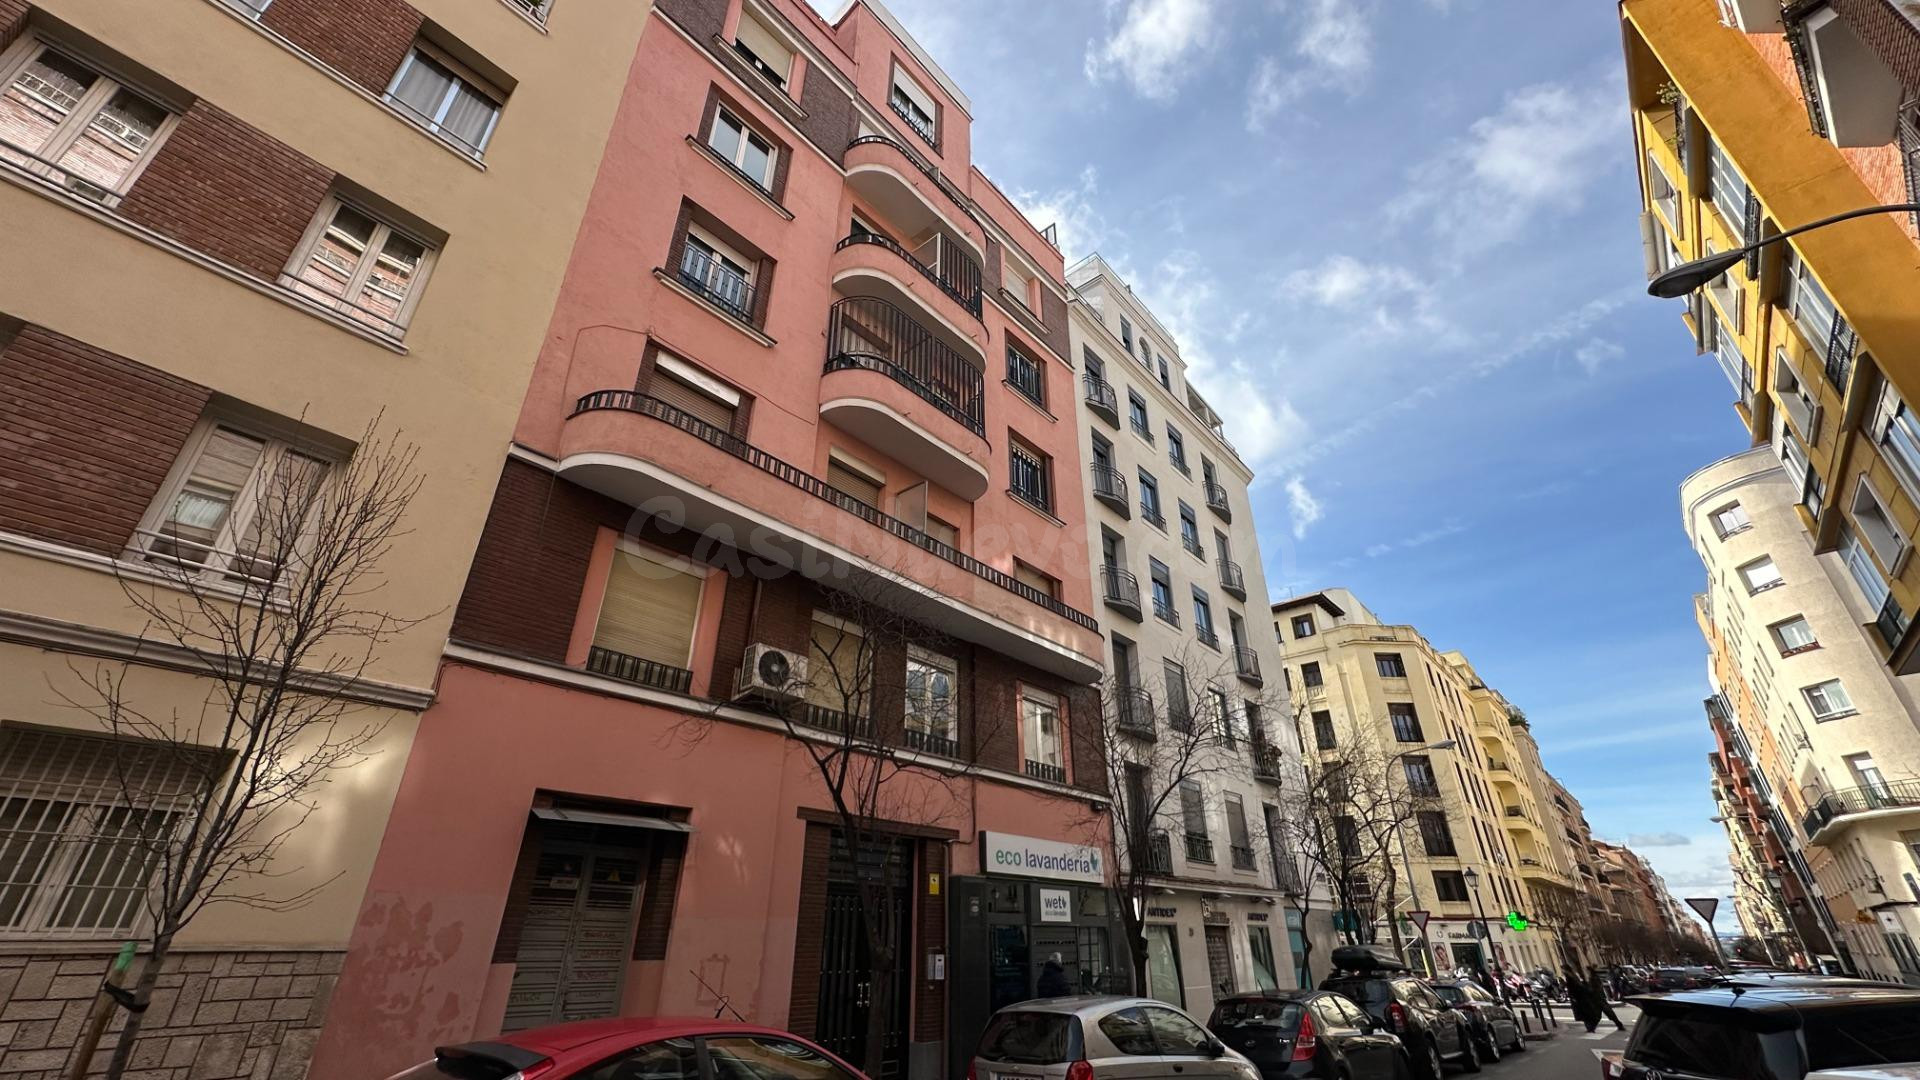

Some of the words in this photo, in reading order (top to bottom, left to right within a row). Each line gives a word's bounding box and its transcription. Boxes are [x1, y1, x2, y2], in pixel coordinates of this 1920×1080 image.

[995, 849, 1021, 866] eco
[1025, 848, 1090, 874] lavandería
[1044, 895, 1062, 909] wet
